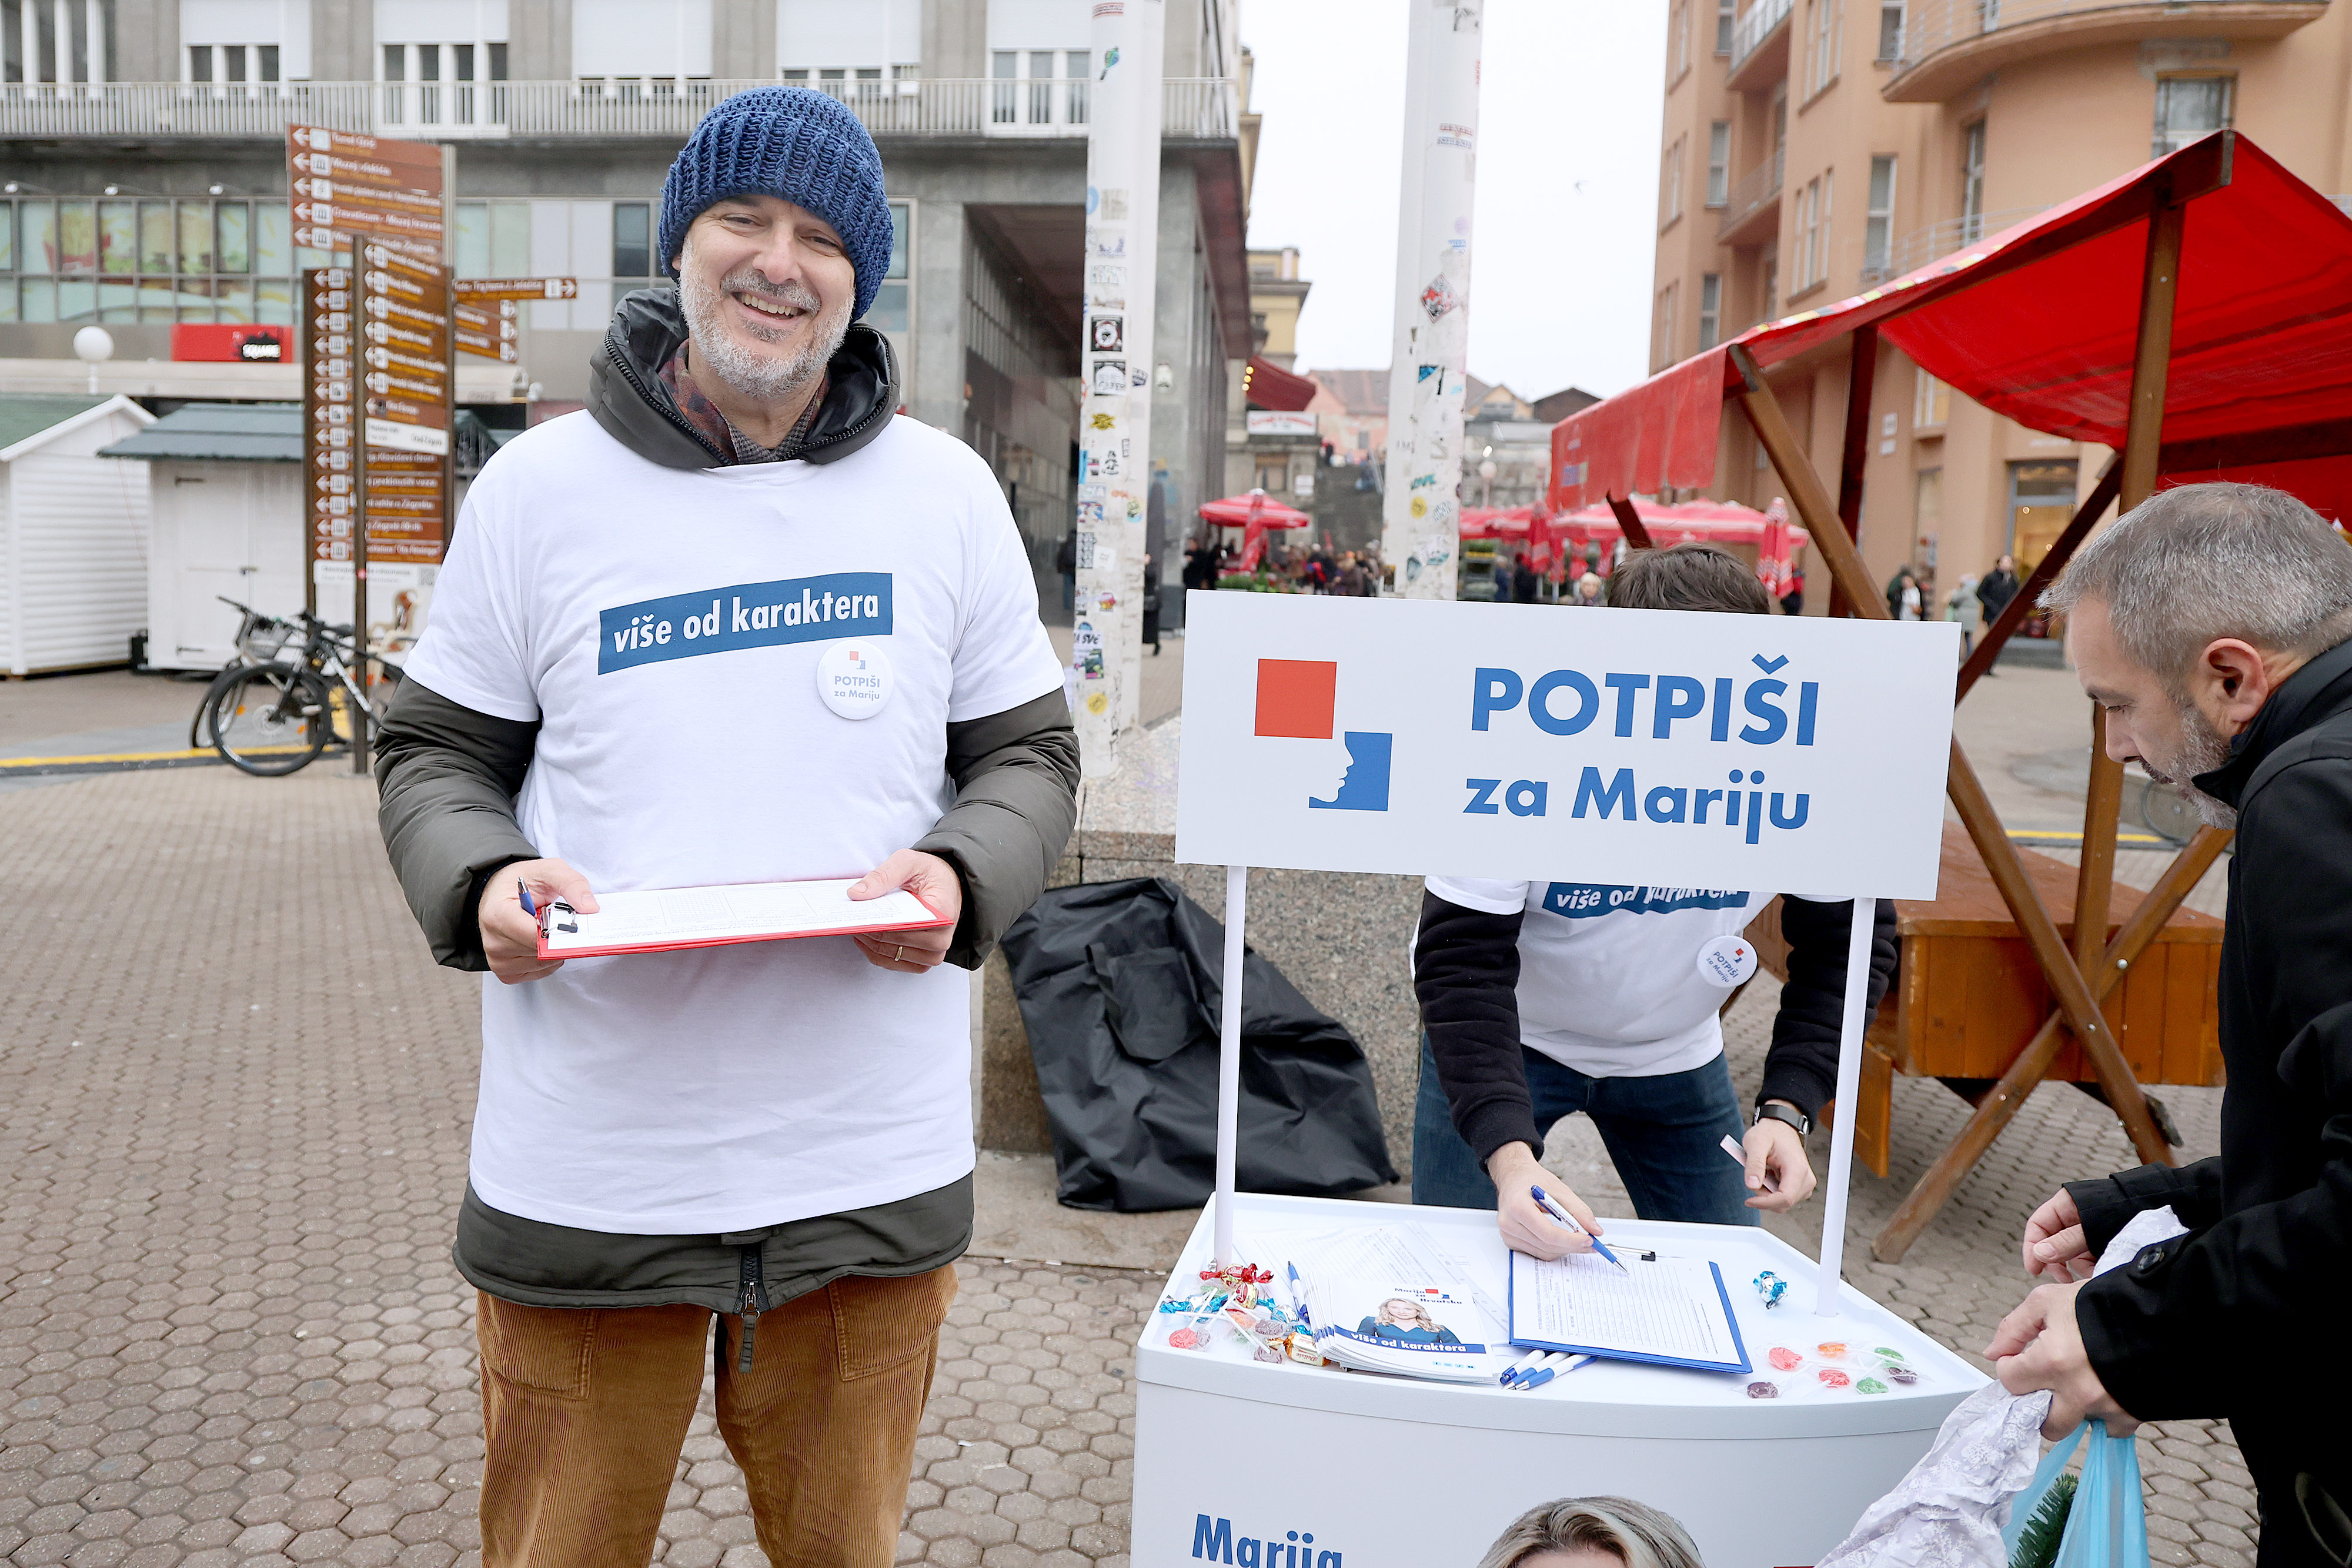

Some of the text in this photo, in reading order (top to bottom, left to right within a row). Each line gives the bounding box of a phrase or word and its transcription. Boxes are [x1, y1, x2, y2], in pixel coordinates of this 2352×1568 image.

[613, 588, 879, 653] više od karaktera
[834, 674, 880, 688] POTPIŠI
[848, 690, 880, 701] Mariju
[1471, 653, 1819, 747] POTPIŠI
[1464, 766, 1810, 845] za Mariju
[1557, 888, 1601, 910] više
[1609, 886, 1640, 906] od
[1713, 951, 1739, 978] POTPIŠI
[1713, 965, 1729, 982] Mariju
[1351, 1332, 1467, 1352] više od karaktera
